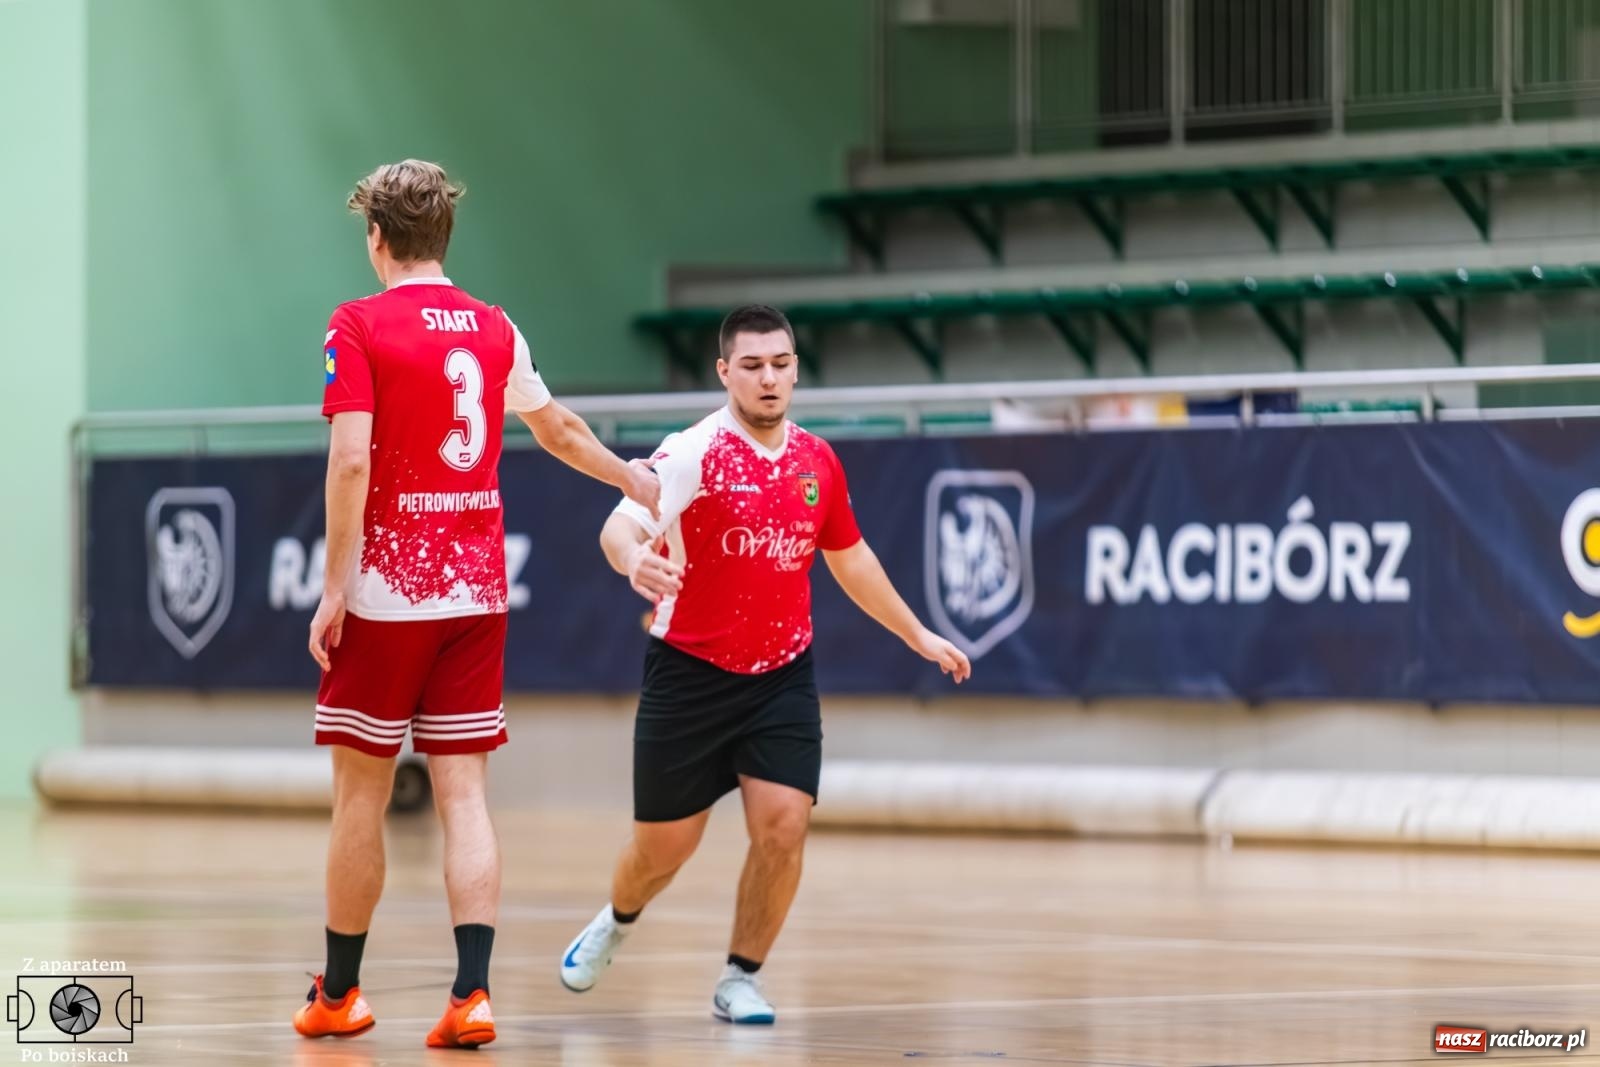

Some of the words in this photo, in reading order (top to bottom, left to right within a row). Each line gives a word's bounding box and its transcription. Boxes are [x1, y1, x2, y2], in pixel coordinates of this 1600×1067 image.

[421, 308, 479, 332] START
[438, 347, 487, 472] 3
[1085, 495, 1411, 604] RACIBÓRZ
